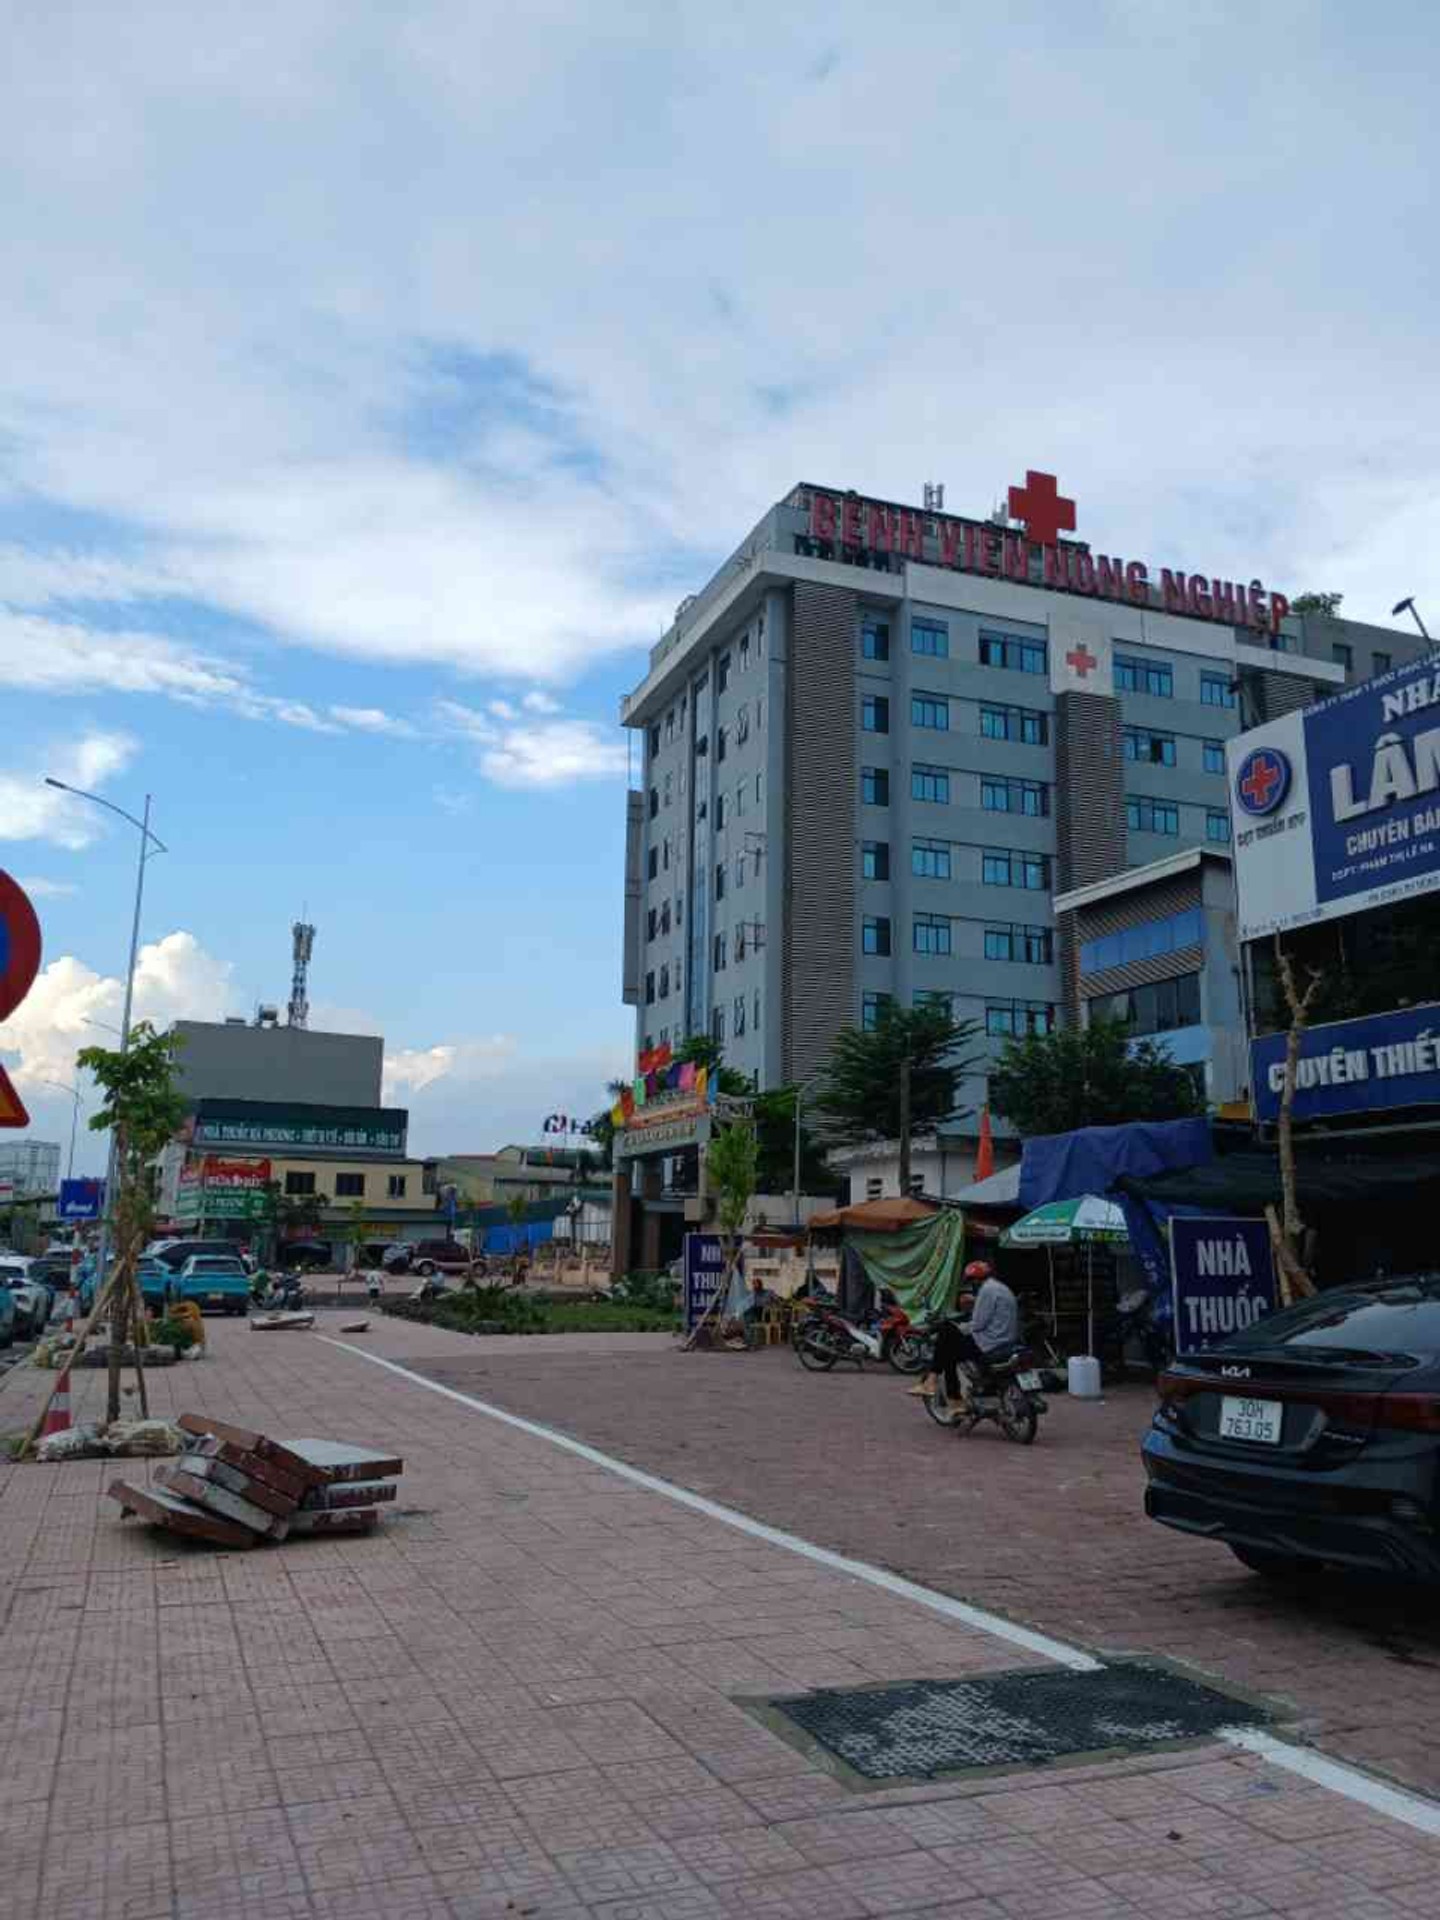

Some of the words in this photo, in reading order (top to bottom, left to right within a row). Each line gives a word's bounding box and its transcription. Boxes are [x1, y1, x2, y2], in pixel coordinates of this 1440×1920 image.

[1162, 568, 1290, 636] NGHIỆP
[1381, 662, 1440, 724] NH
[700, 1244, 722, 1262] NH
[1196, 1232, 1252, 1277] NHÀ
[692, 1271, 722, 1290] THU
[1183, 1283, 1269, 1335] THUỐC
